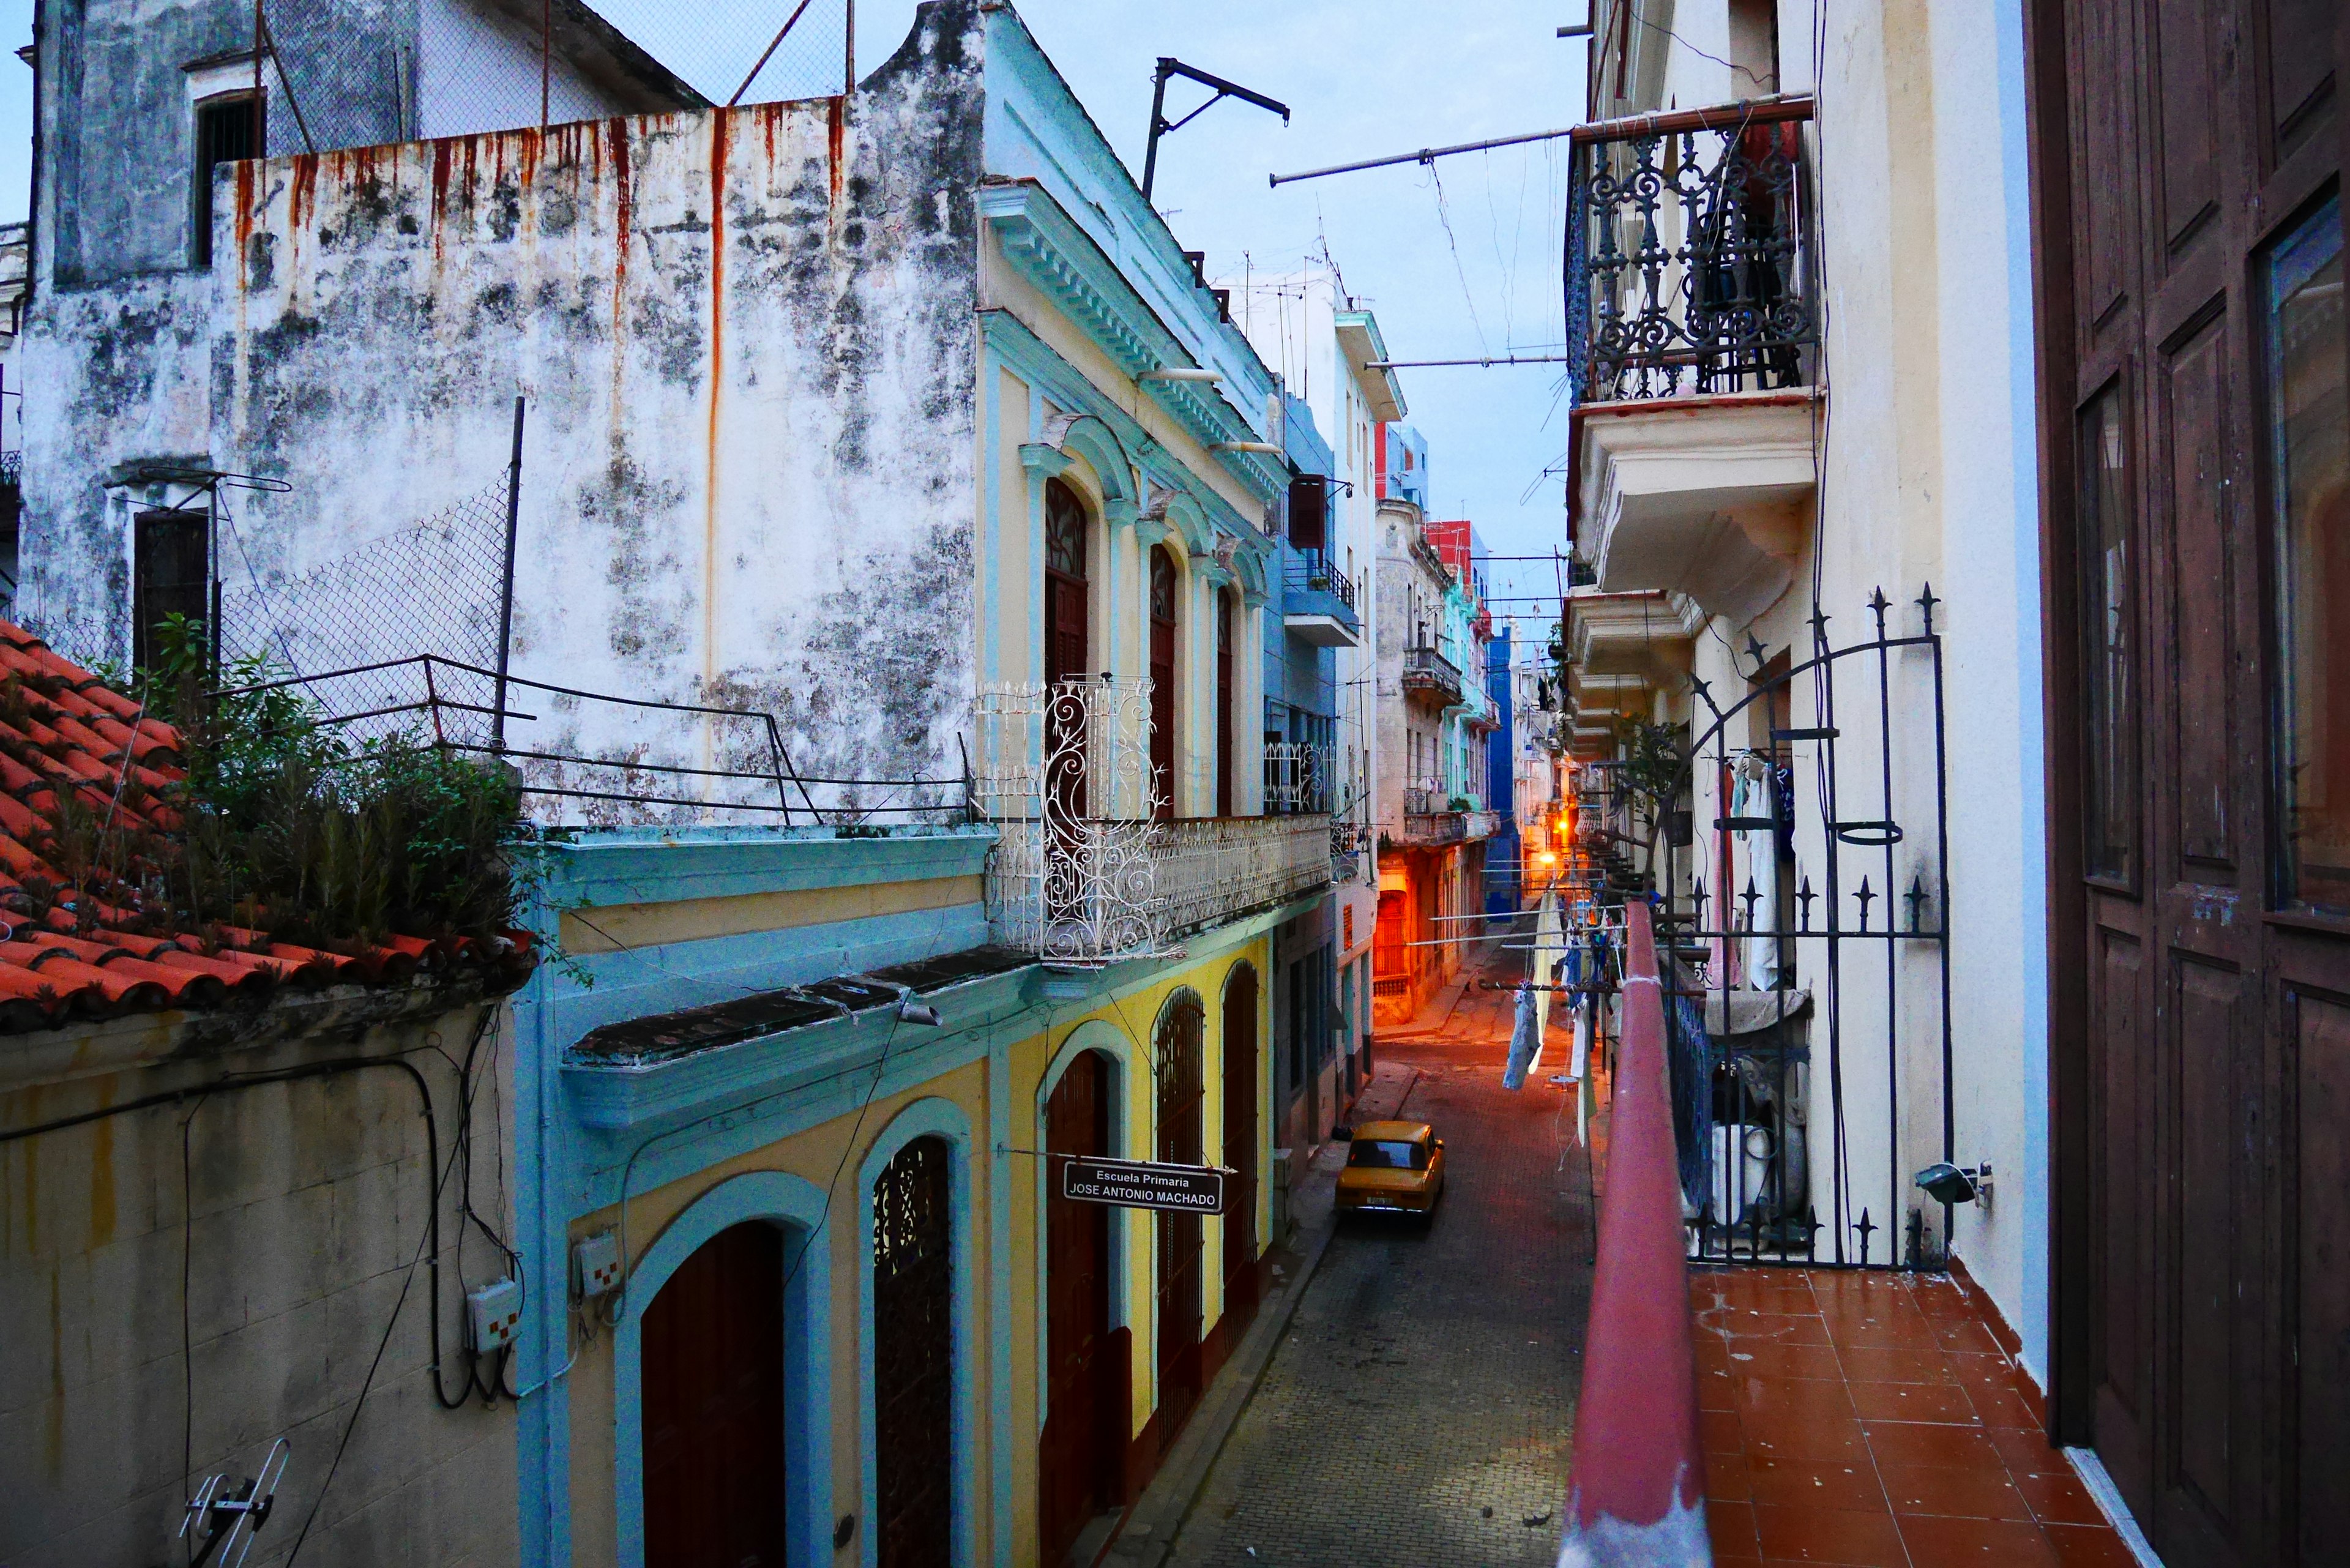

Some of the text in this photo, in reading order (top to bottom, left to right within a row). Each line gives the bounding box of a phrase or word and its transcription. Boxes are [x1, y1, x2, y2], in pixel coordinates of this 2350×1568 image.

[1097, 1170, 1189, 1187] Escuela Primaria
[1070, 1183, 1215, 1205] JOSE ANTONIO MACHADO
